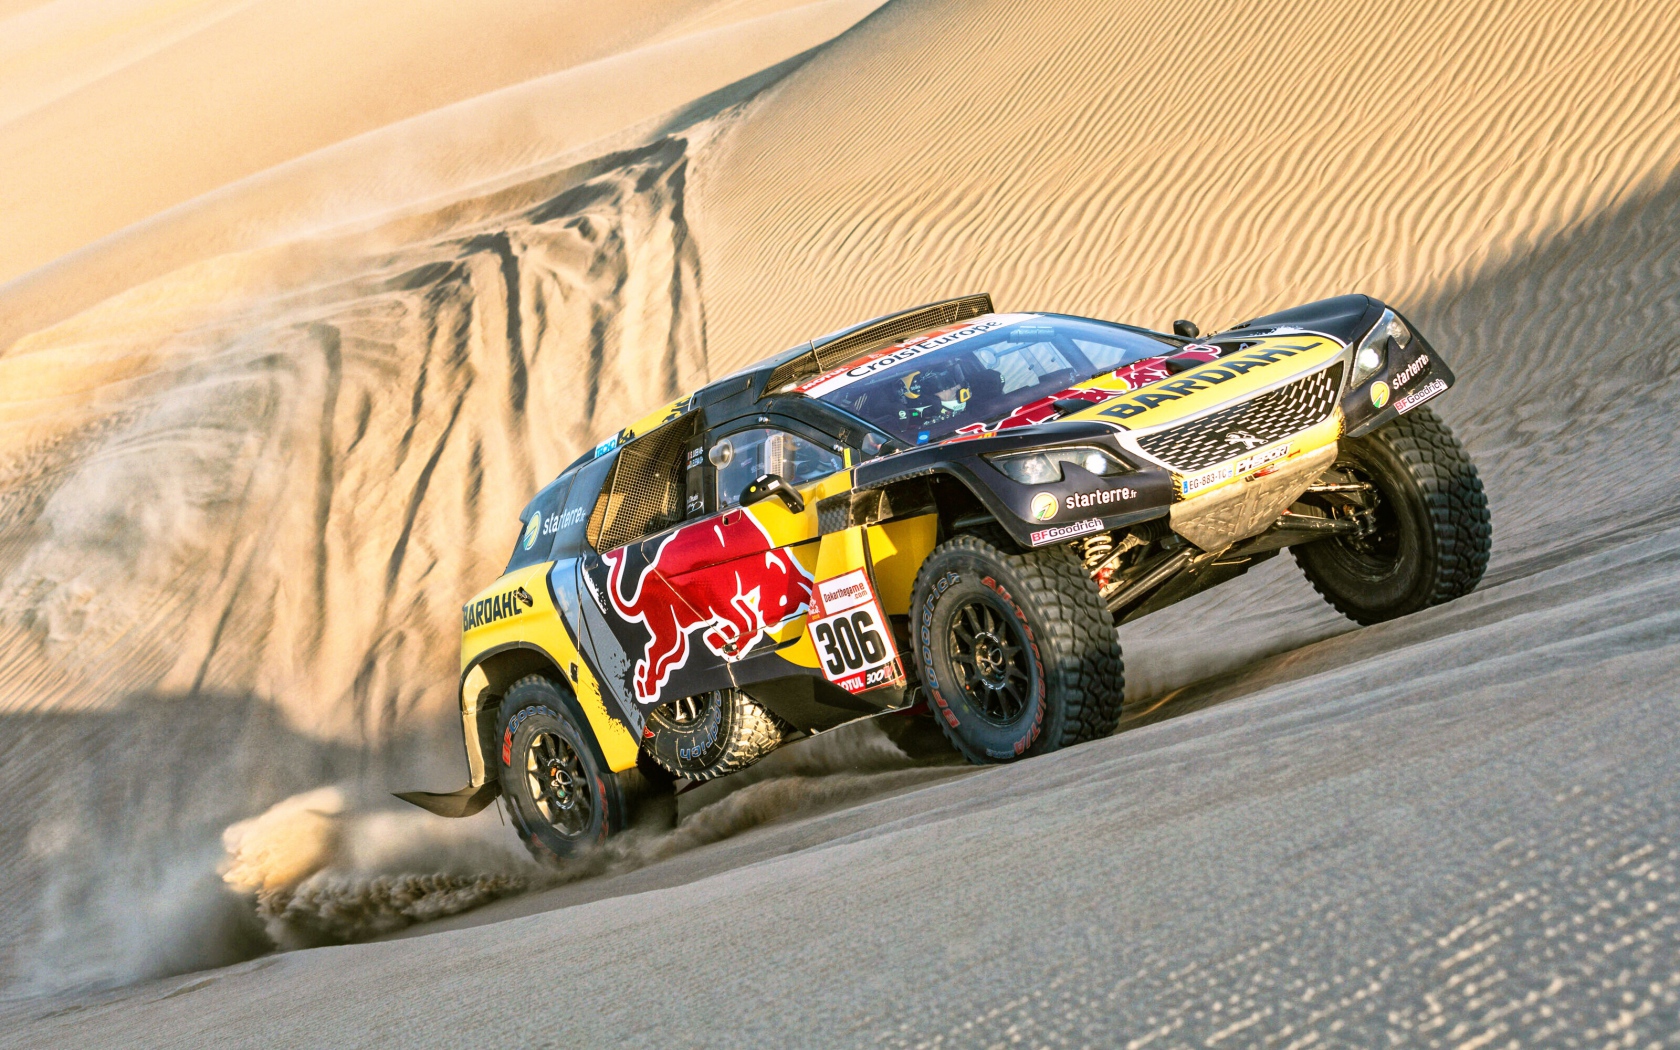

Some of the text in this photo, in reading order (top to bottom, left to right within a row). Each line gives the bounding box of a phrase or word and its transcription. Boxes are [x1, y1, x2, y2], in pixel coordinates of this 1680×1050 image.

[846, 321, 1003, 377] CroisiEurope
[1097, 341, 1323, 419] BARDAHL
[1394, 378, 1445, 410] BFGoodrich
[1066, 487, 1137, 509] starterre.fr
[1189, 470, 1227, 490] EG-883-TC
[1031, 518, 1102, 542] BFGoodrich
[463, 590, 522, 632] BARDAHL
[816, 610, 886, 675] 306
